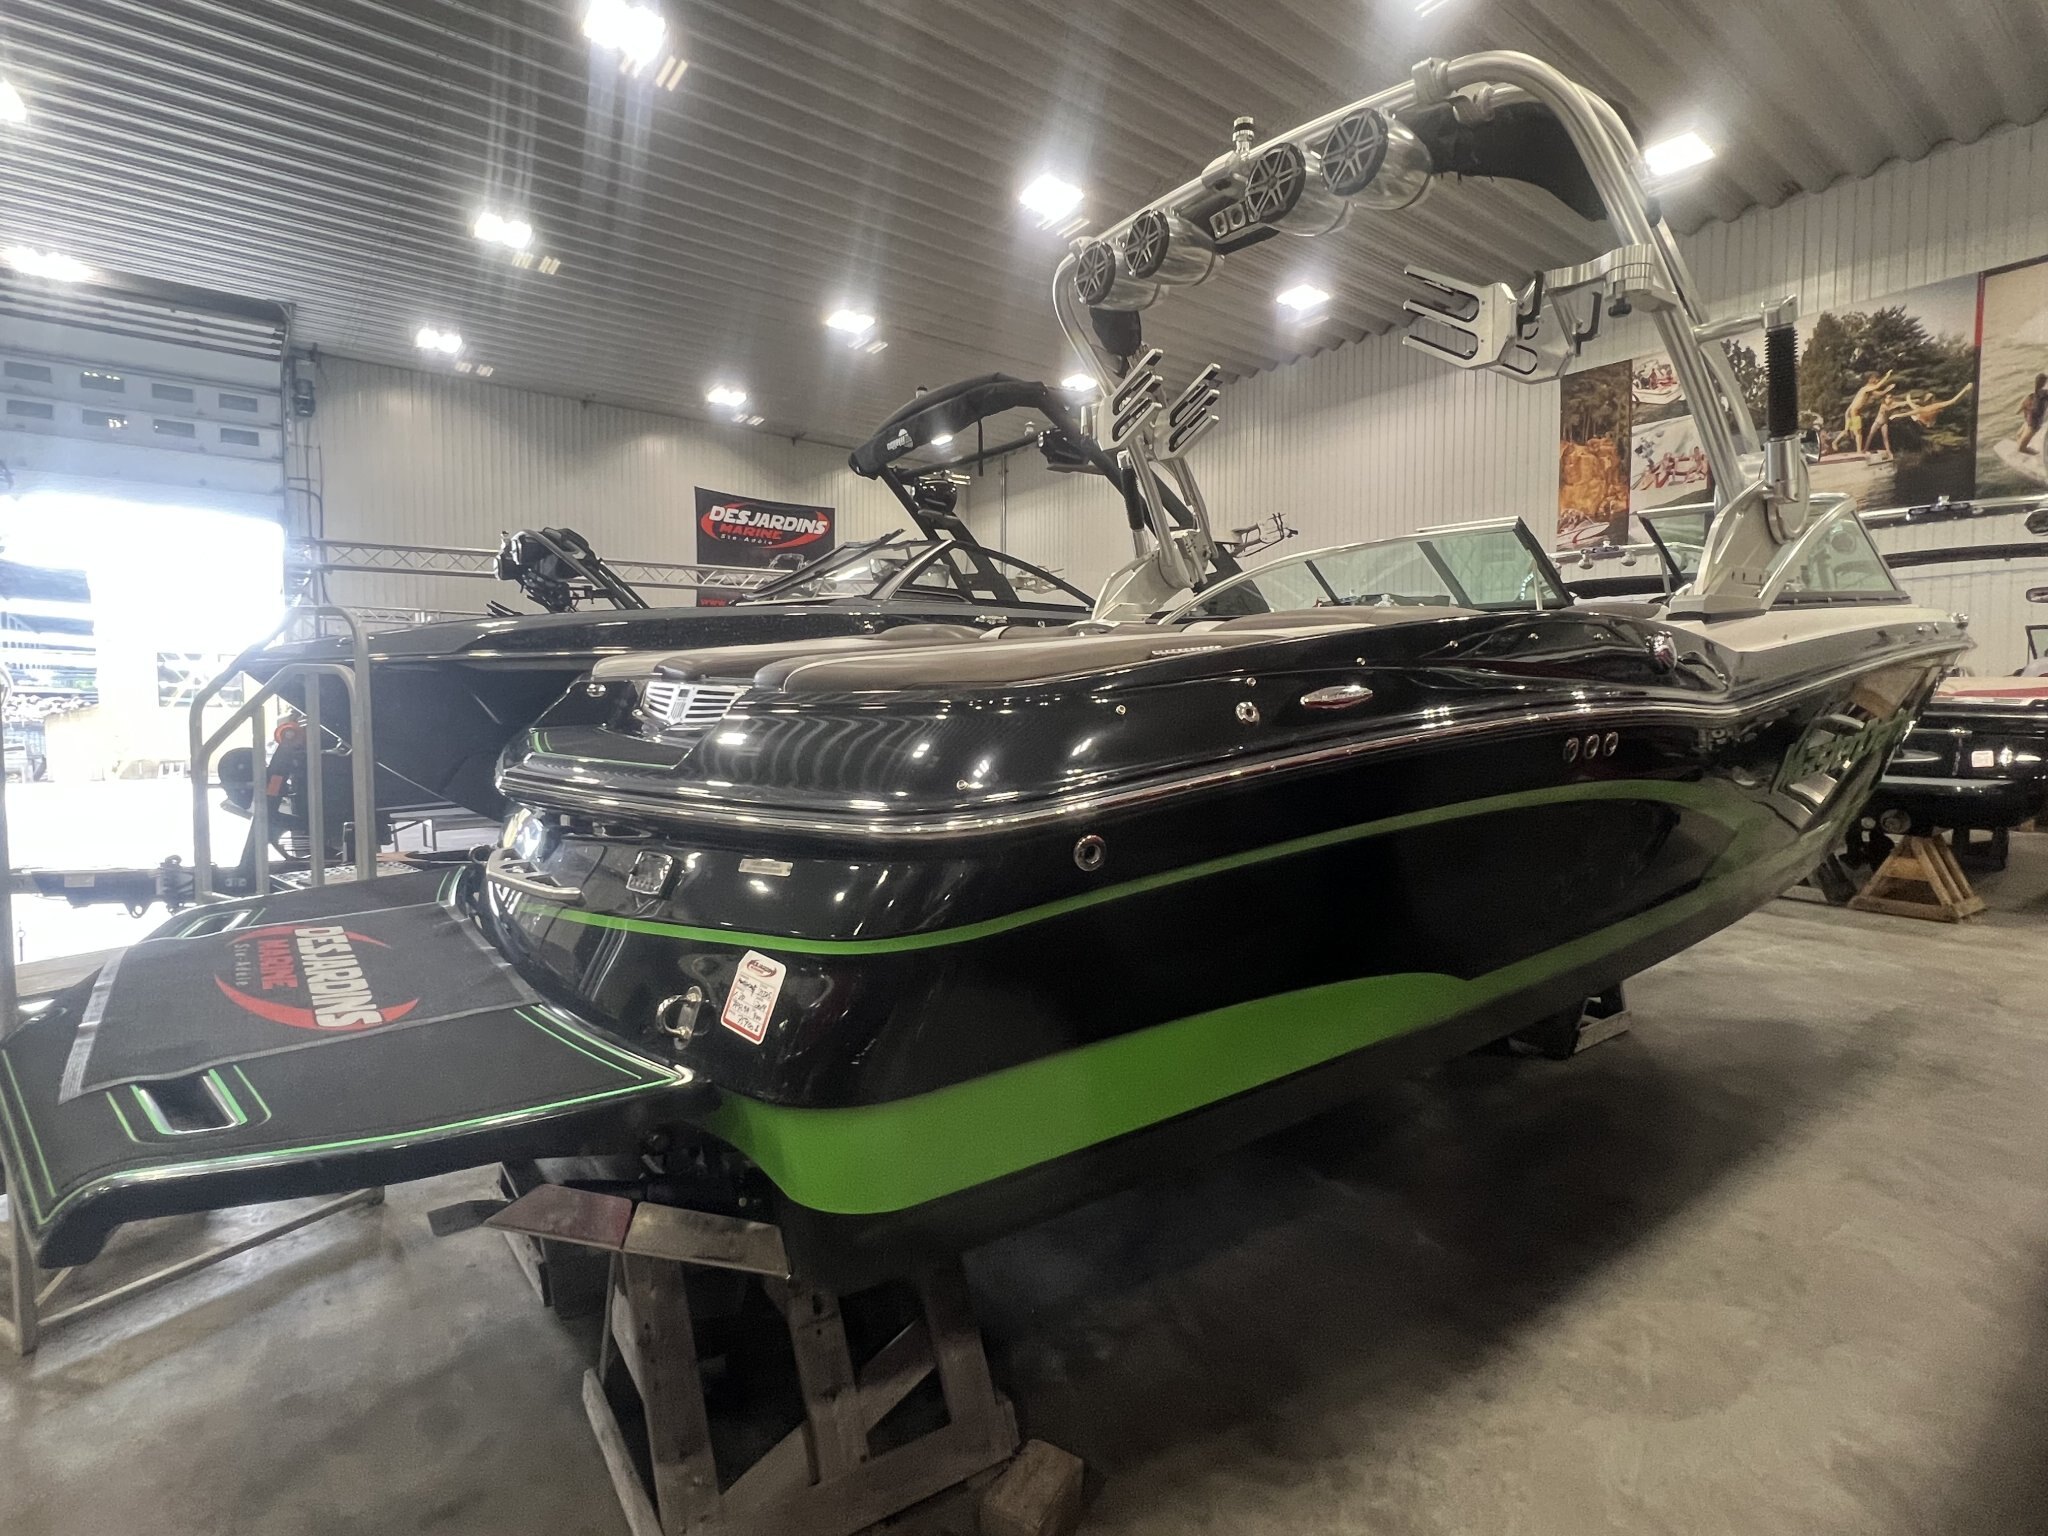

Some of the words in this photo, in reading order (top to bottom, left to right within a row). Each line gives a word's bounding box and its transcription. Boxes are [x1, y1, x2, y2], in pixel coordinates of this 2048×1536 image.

[709, 505, 828, 535] DESJARDINS
[719, 523, 784, 540] MARINE
[257, 939, 298, 990] MARINE
[294, 926, 383, 1027] DESJARDINS
